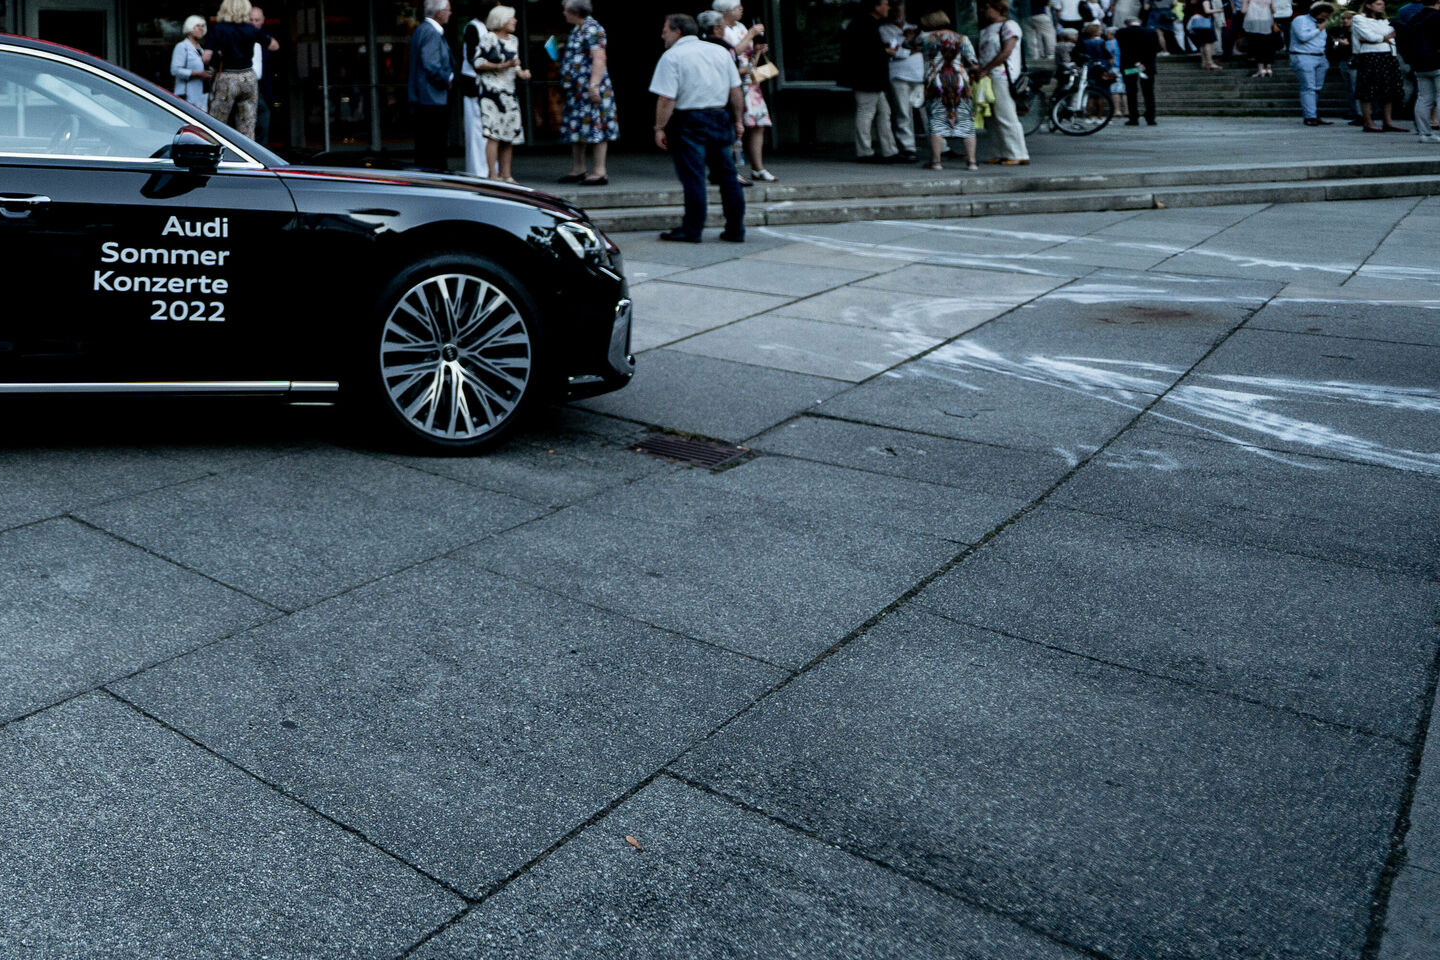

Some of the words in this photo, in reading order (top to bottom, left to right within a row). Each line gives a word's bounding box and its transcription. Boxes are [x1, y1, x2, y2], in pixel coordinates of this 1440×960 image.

[162, 216, 228, 237] Audi
[101, 242, 230, 266] Sommer
[94, 270, 228, 294] Konzerte
[150, 300, 226, 322] 2022
